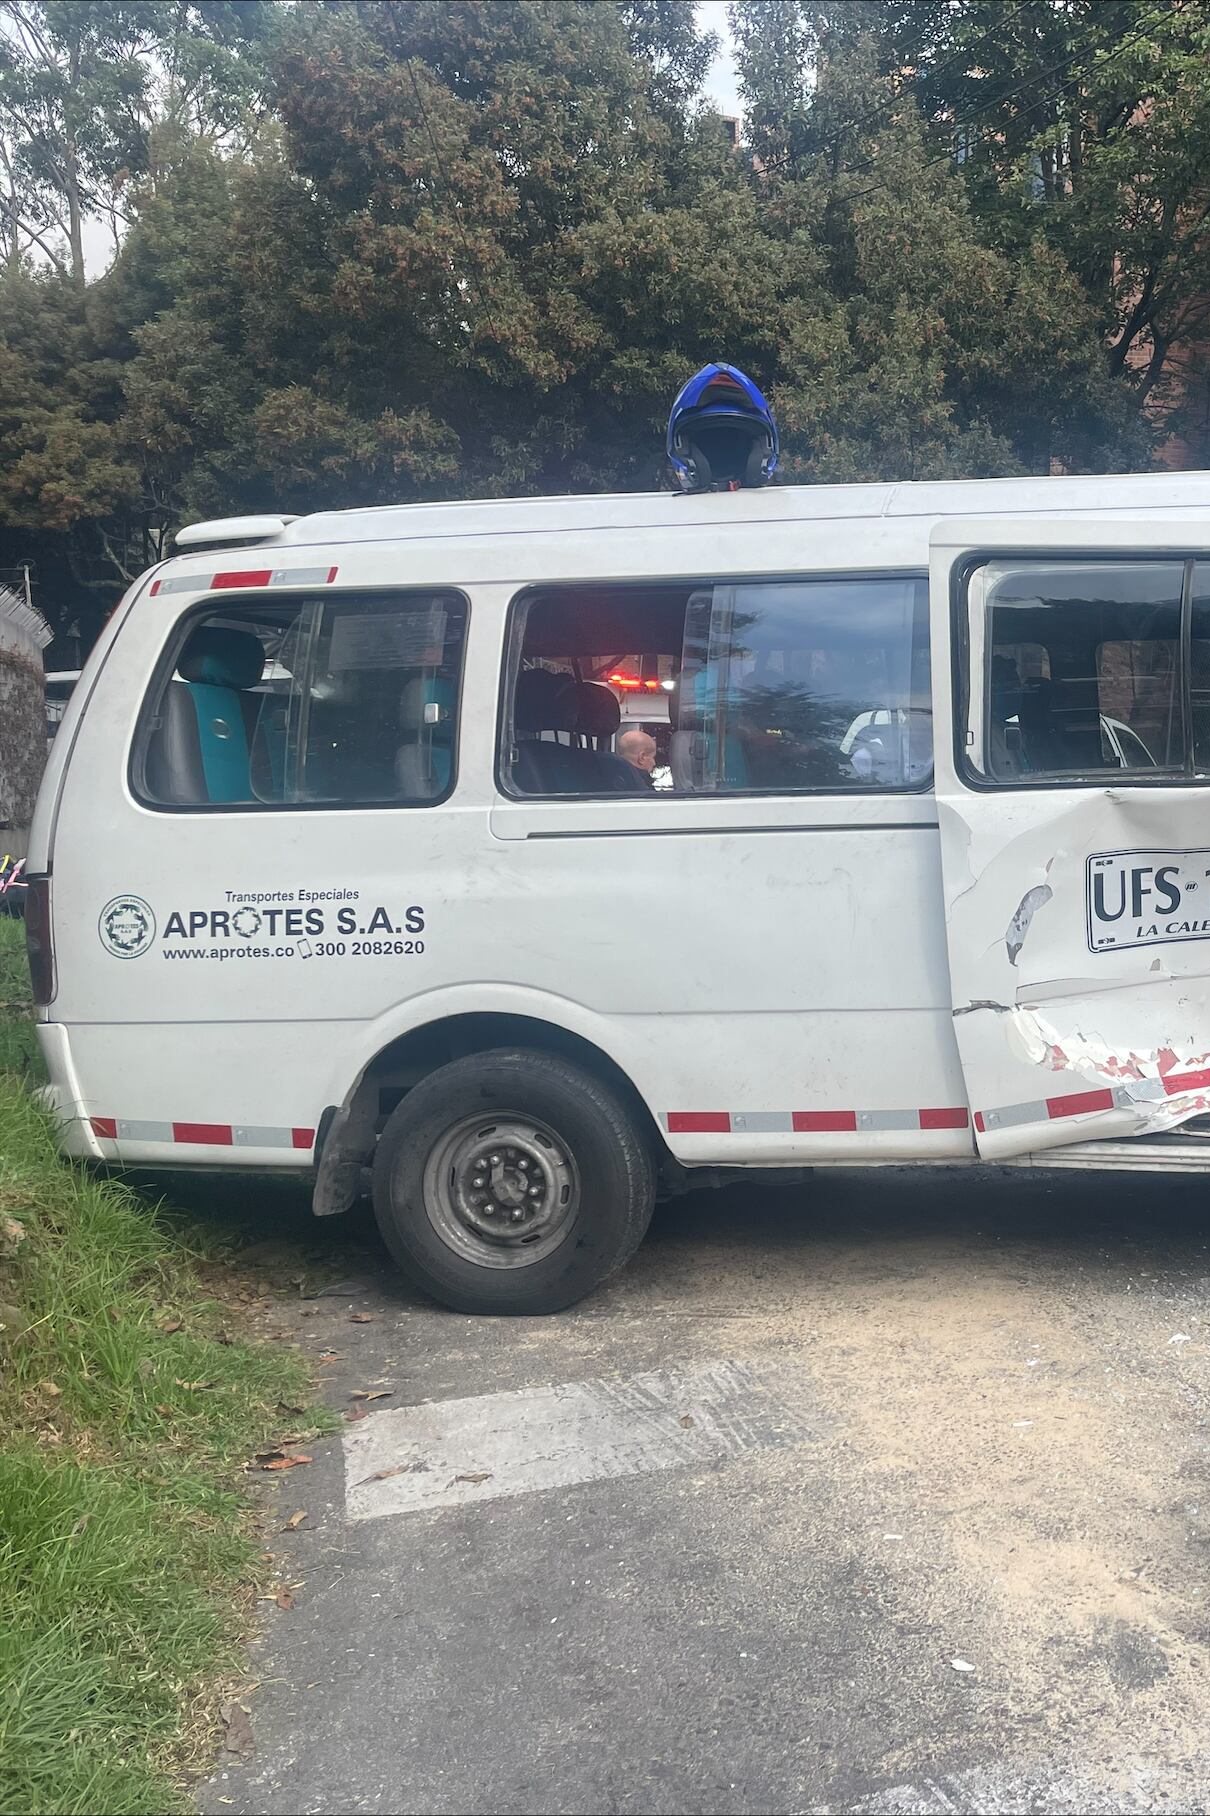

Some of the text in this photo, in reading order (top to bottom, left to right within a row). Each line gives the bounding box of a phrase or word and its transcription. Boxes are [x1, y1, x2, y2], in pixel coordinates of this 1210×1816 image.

[225, 888, 360, 904] Transportes Especiales
[1093, 866, 1181, 922] UFS
[162, 905, 425, 939] APROTES S.A.S
[1136, 925, 1159, 938] LA
[162, 945, 294, 962] www.aprotes.co
[315, 942, 346, 956] 300
[351, 941, 425, 955] 2082620
